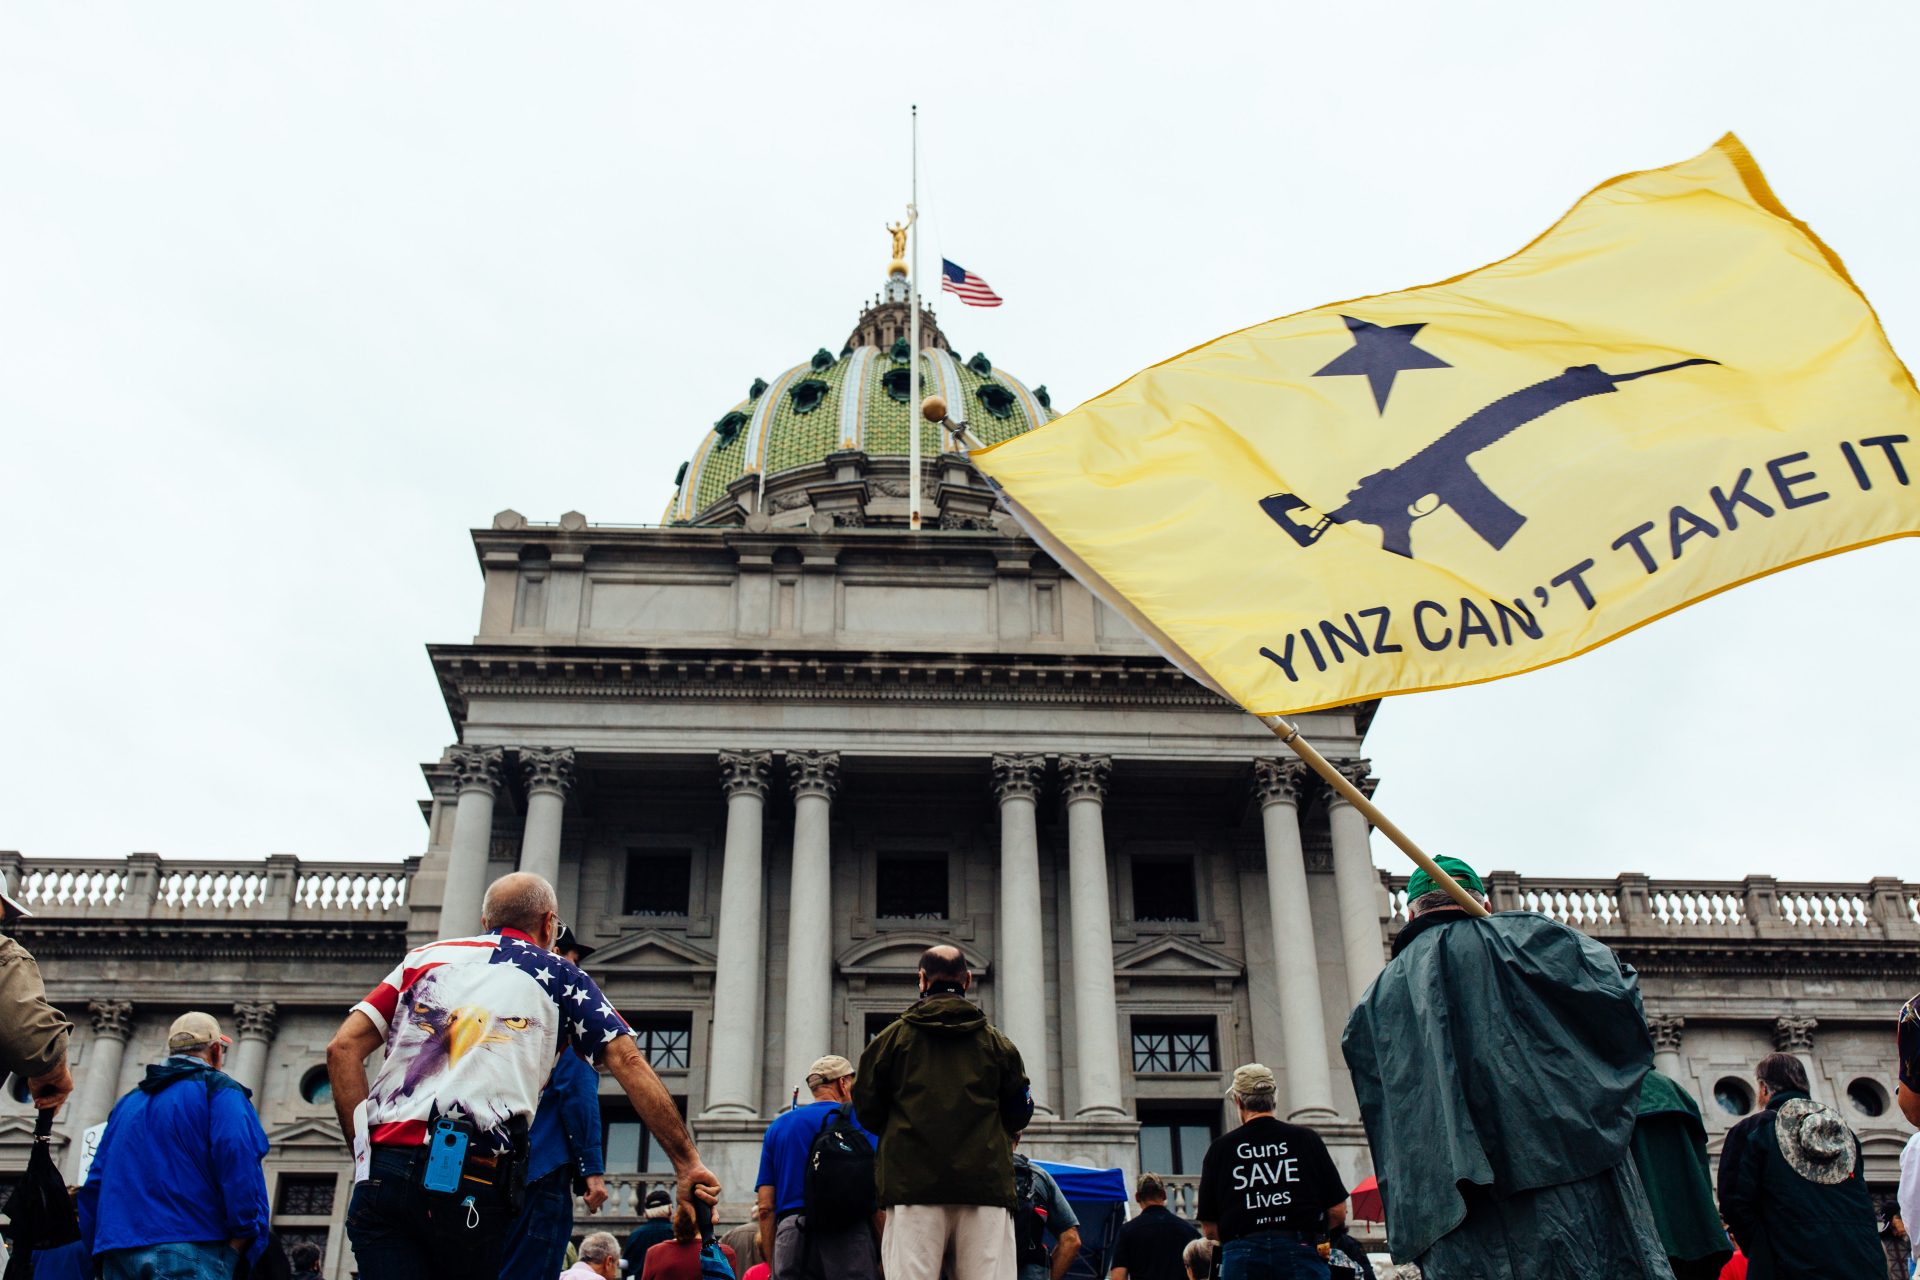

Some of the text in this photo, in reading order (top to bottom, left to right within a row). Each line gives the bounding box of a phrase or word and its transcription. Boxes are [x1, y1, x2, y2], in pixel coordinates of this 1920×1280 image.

[1259, 434, 1911, 683] YINZ CAN'T TAKE IT
[1236, 1142, 1288, 1159] Guns
[1232, 1158, 1300, 1190] SAVE
[1246, 1191, 1292, 1210] Lives
